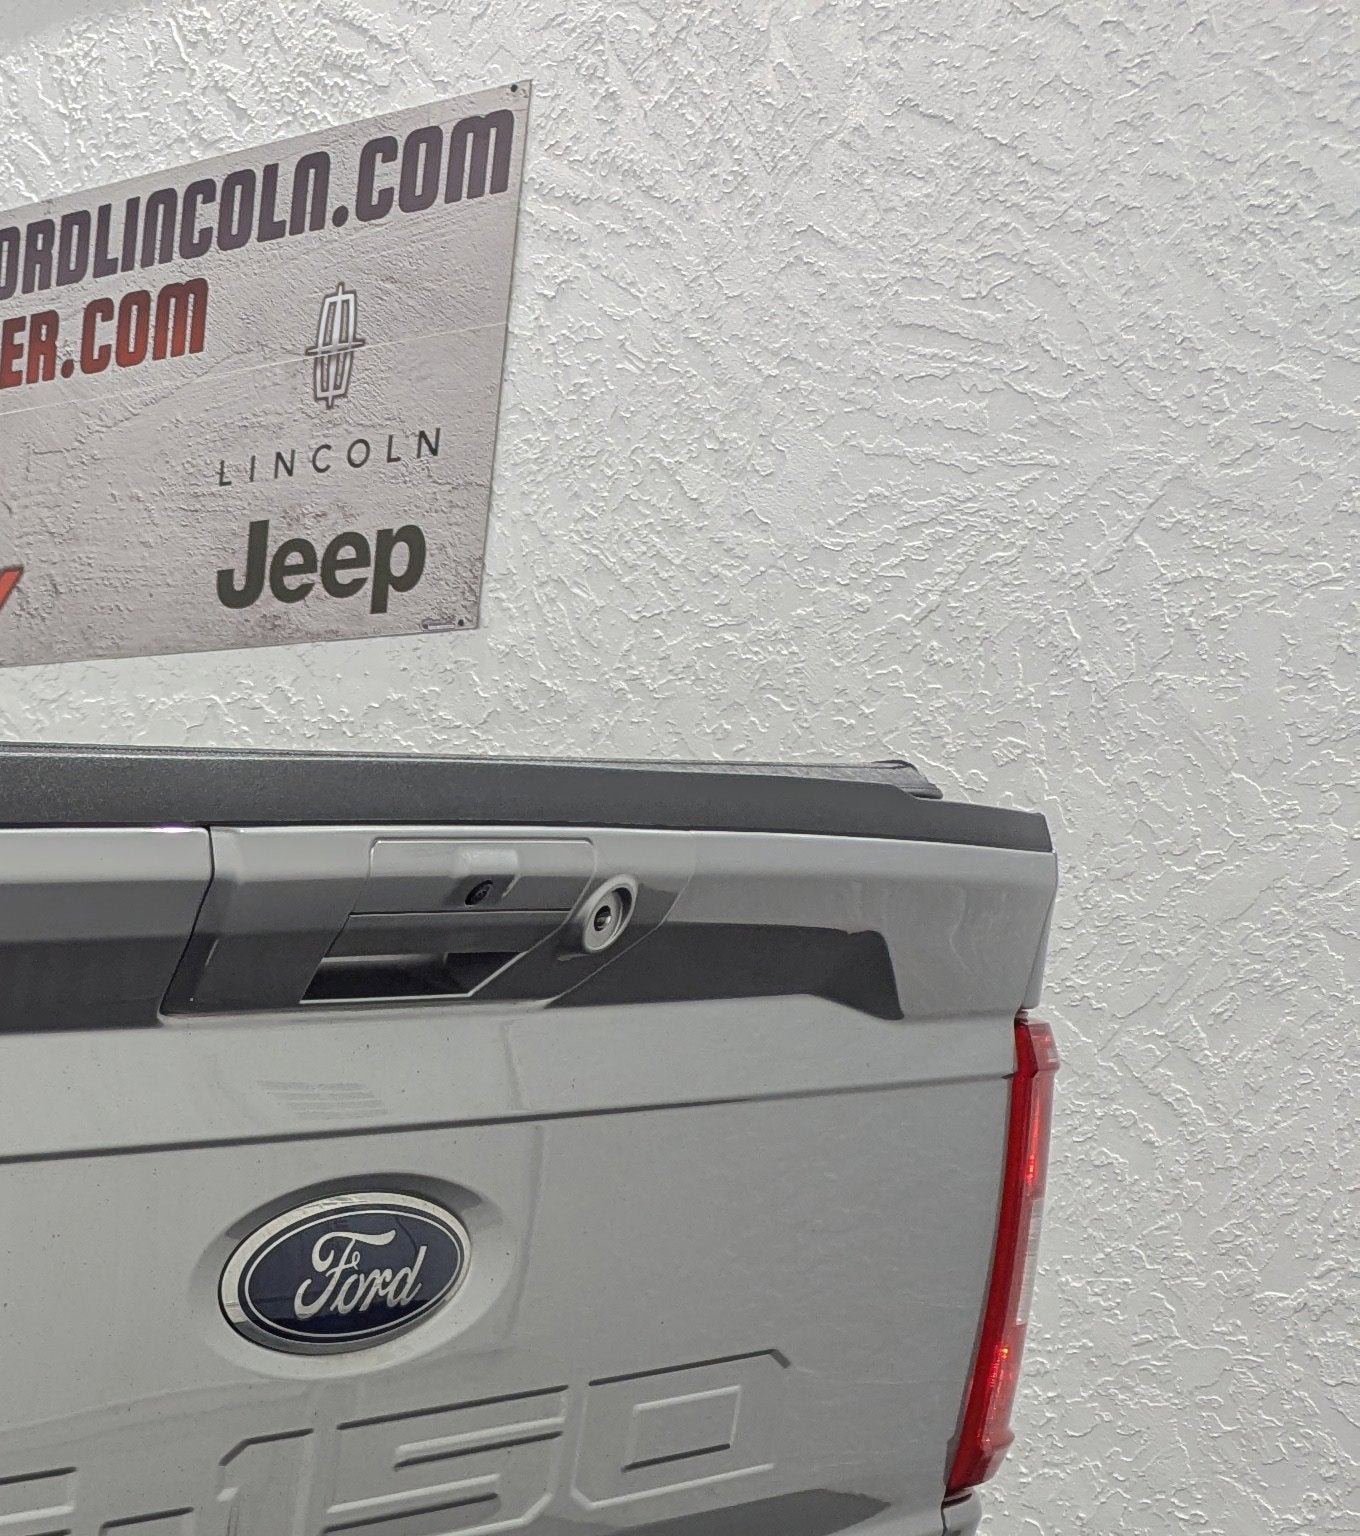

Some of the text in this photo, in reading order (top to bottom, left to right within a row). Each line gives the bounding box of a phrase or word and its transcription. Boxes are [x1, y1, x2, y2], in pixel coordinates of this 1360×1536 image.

[219, 427, 441, 487] LINCOLN
[216, 519, 427, 615] Jeep
[293, 1229, 428, 1321] Ford
